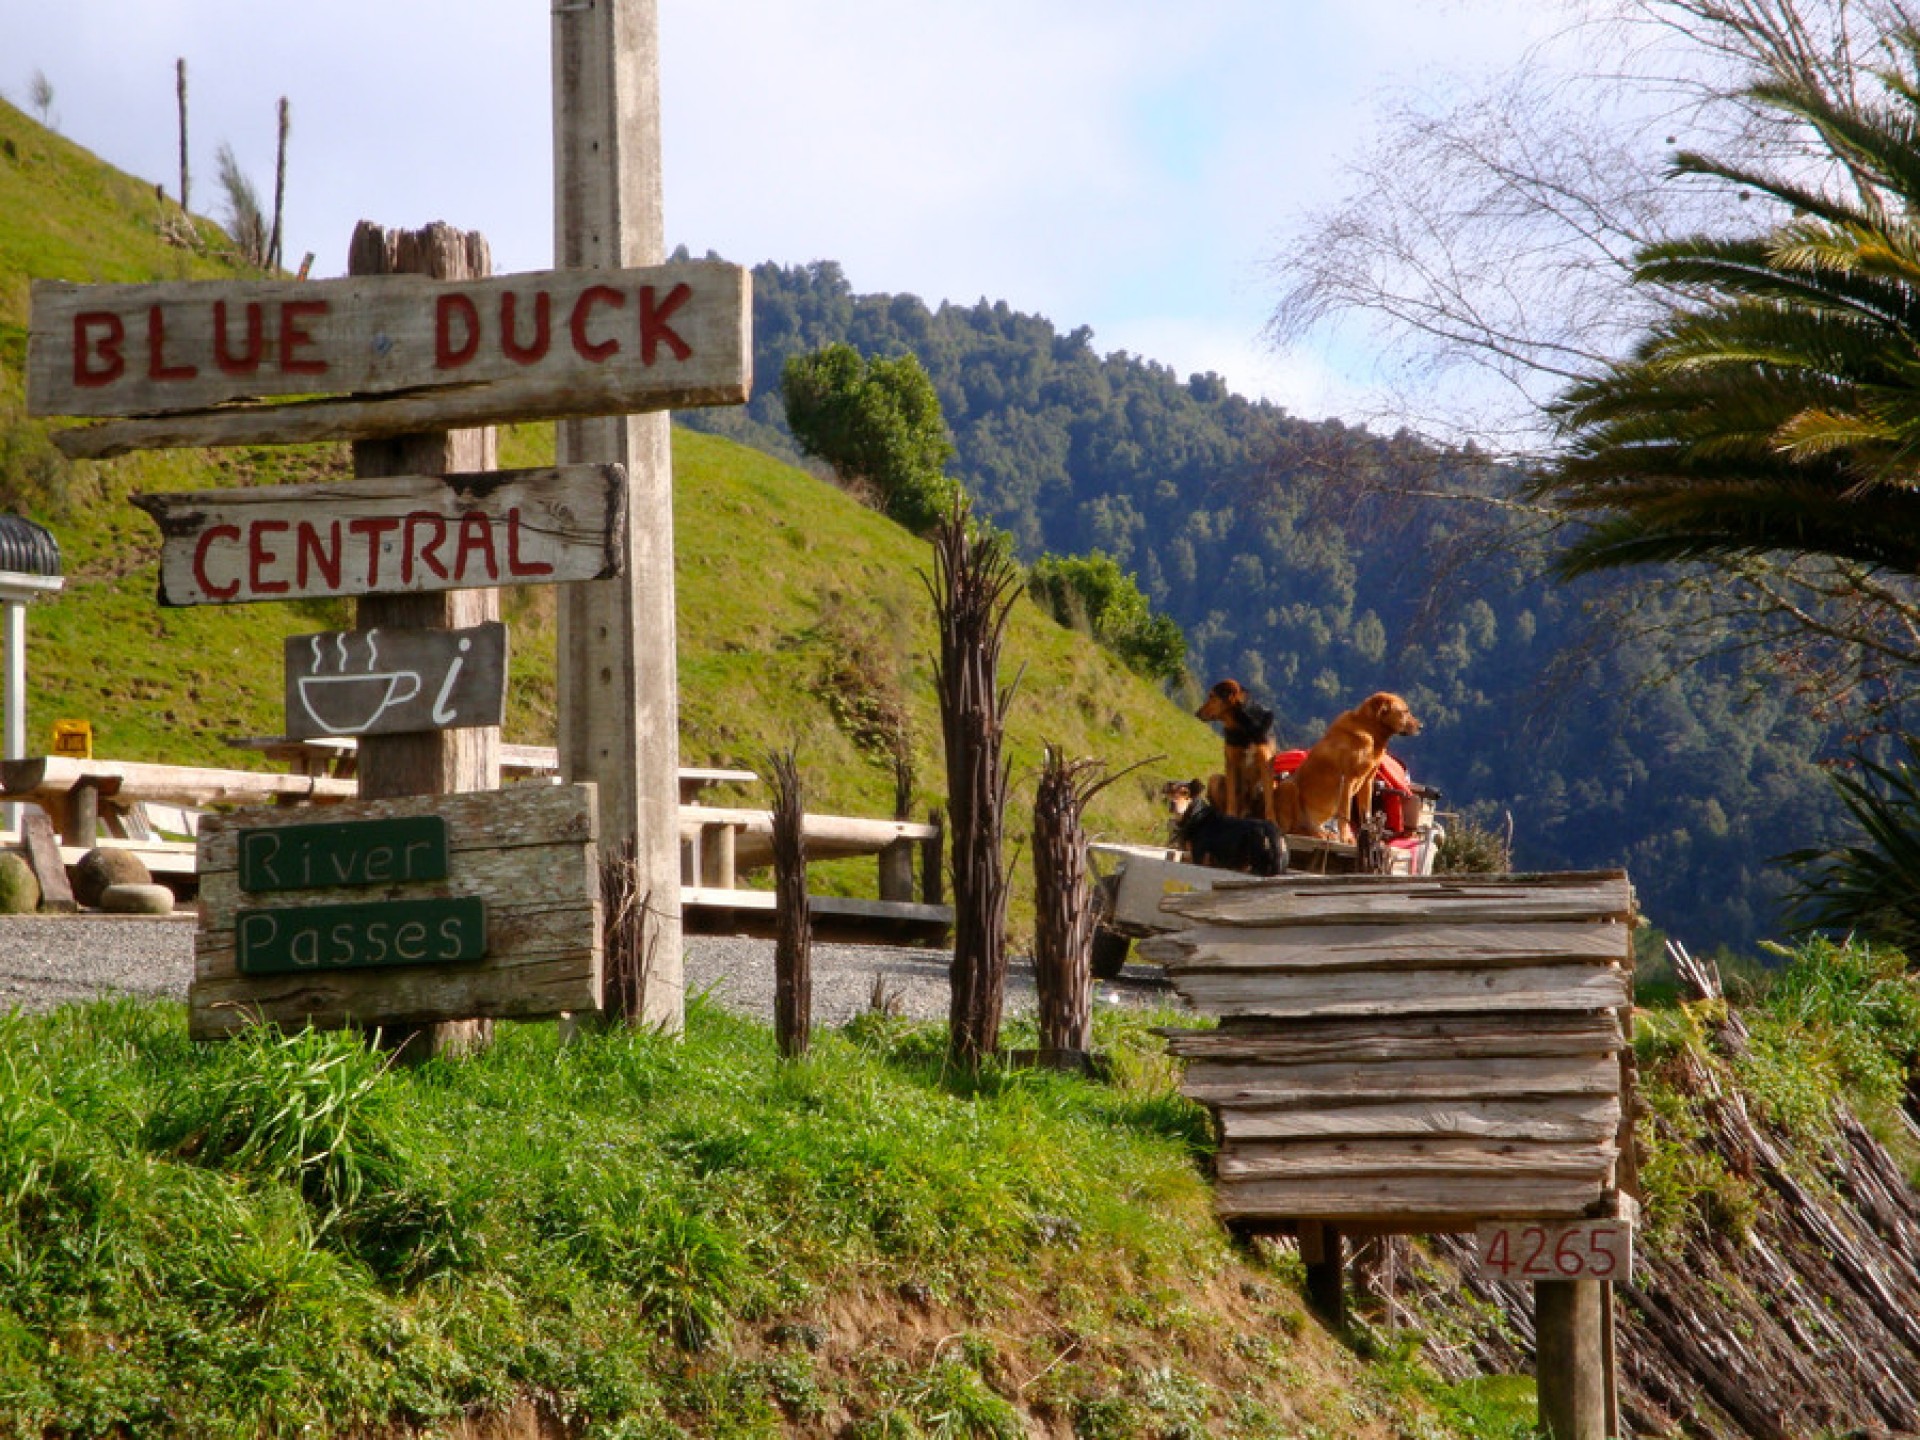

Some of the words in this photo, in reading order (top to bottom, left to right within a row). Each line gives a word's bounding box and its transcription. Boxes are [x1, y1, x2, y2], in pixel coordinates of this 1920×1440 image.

[72, 298, 331, 388] BLUE
[435, 282, 694, 371] DUCK
[192, 507, 554, 599] CENTRAL
[244, 832, 431, 888] River
[242, 914, 463, 969] Passes
[1485, 1227, 1618, 1276] 4265
